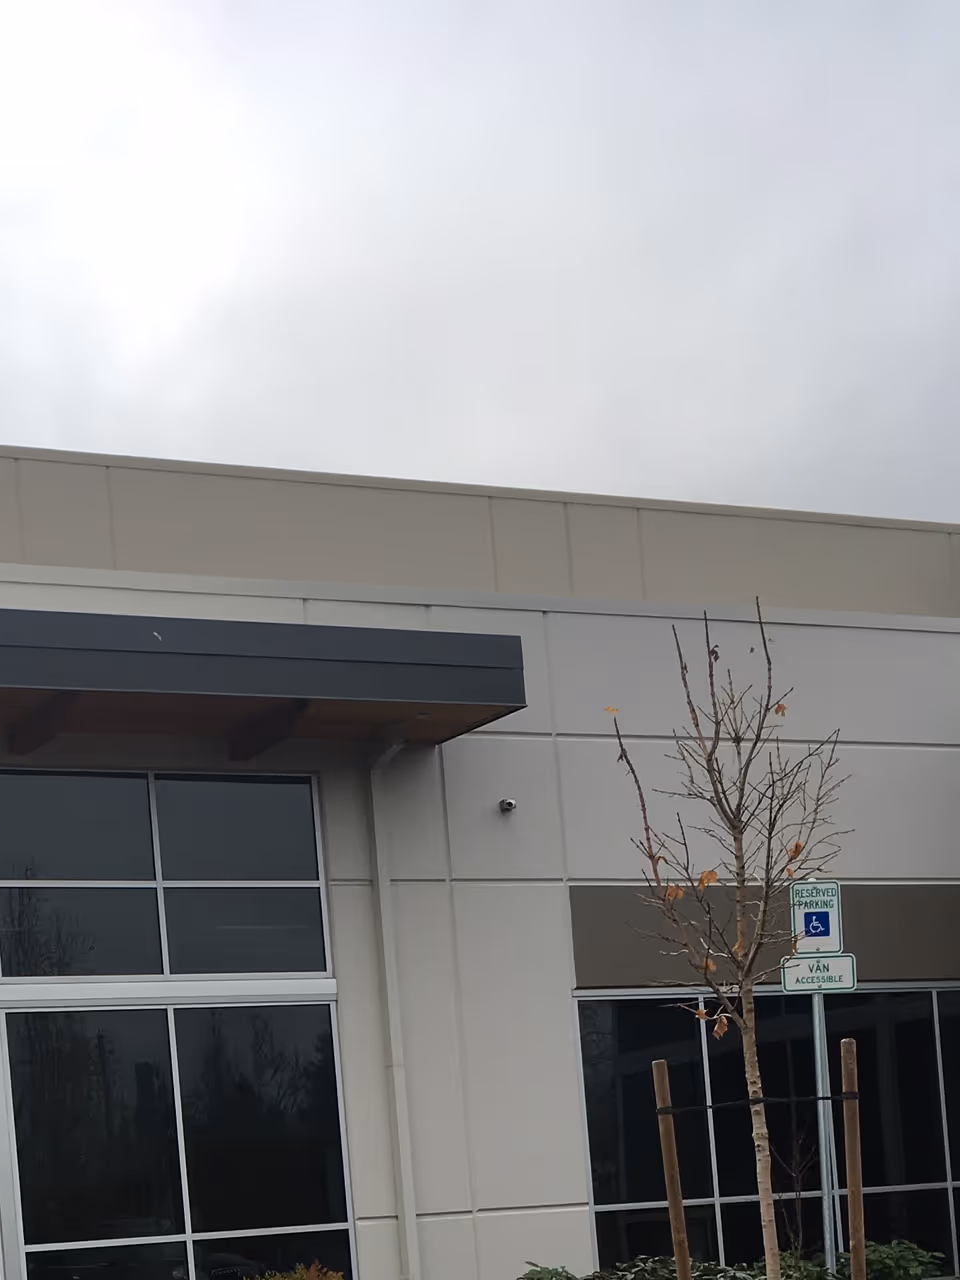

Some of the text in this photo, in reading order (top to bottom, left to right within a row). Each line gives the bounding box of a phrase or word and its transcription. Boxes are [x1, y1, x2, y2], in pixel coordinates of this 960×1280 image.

[795, 888, 836, 898] RESERVED
[798, 899, 834, 909] PARKING
[808, 963, 830, 973] VAN
[795, 975, 843, 984] ACCESSIBLE
